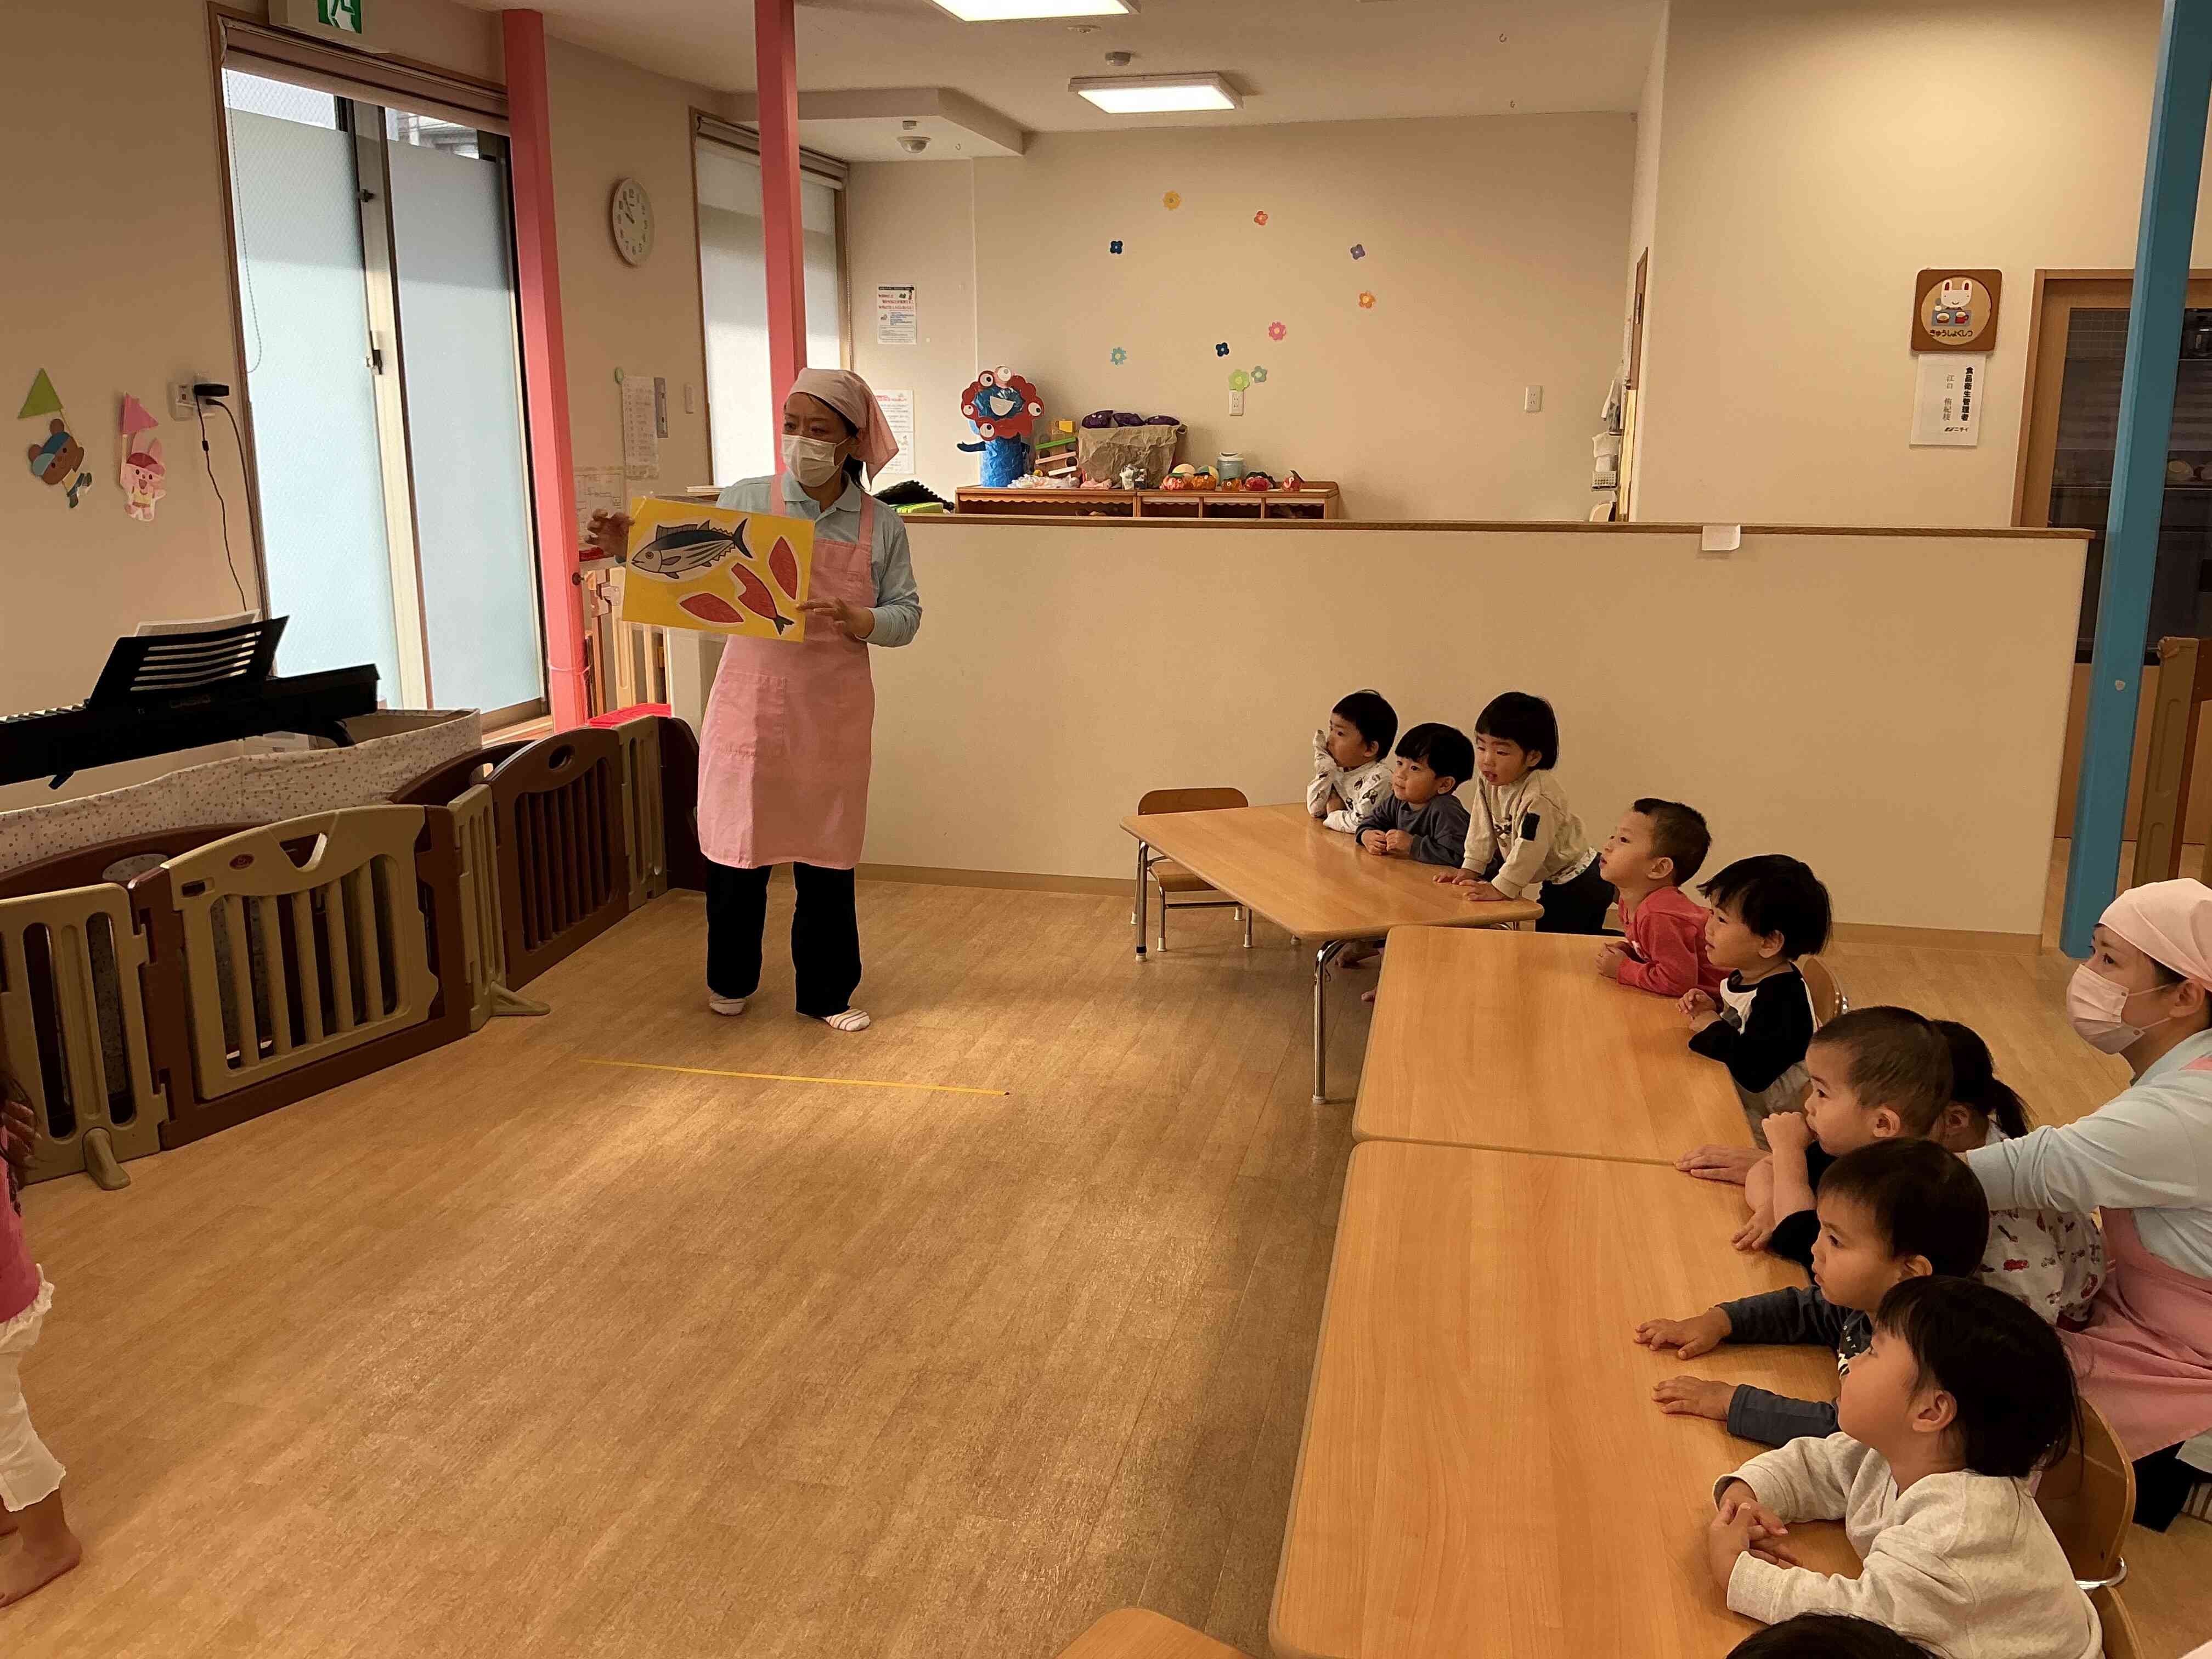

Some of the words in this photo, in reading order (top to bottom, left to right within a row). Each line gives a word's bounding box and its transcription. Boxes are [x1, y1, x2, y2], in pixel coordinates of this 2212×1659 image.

[1929, 329, 1973, 337] きゅうしょくしつ
